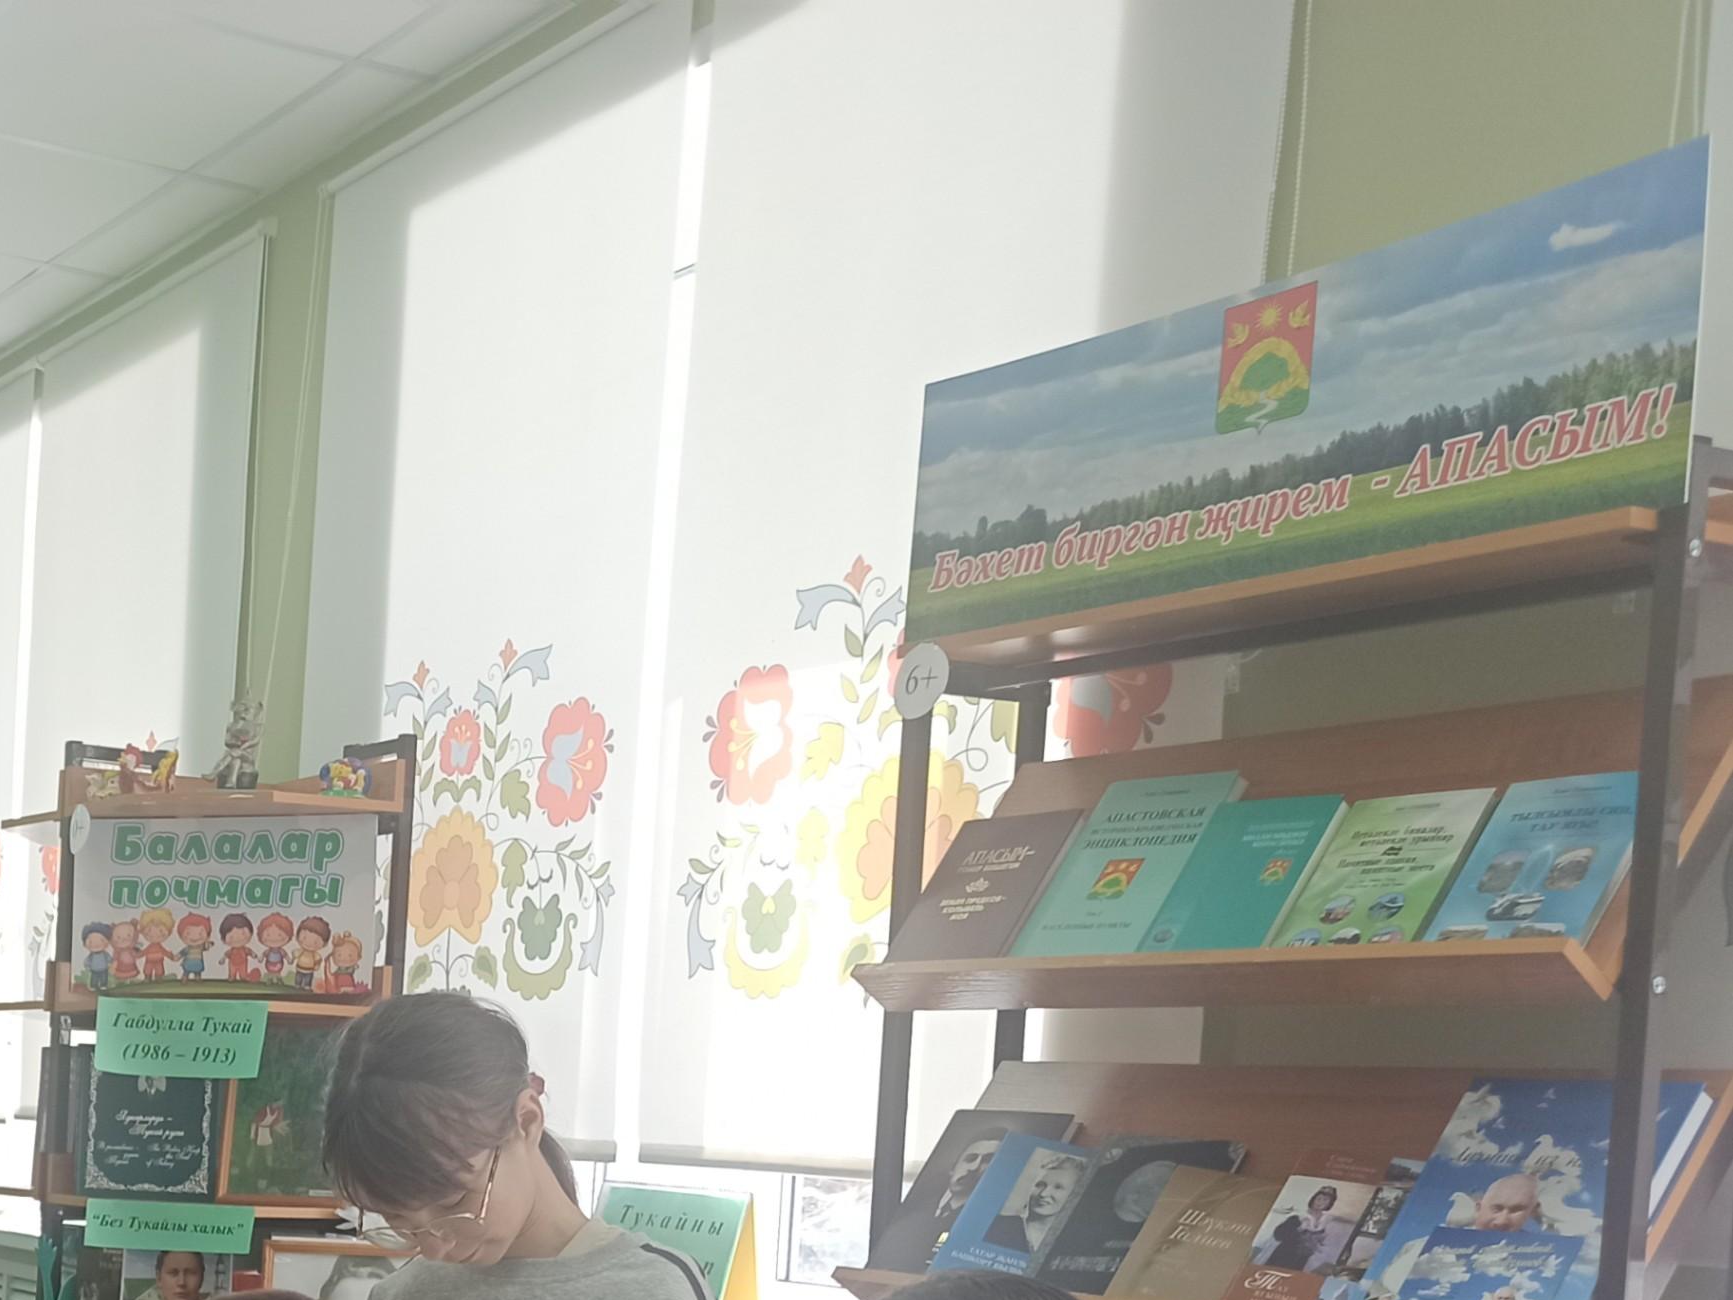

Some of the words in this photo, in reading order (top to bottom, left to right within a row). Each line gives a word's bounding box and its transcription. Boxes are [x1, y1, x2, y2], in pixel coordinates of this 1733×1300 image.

[929, 540, 1047, 593] Бәхет
[1053, 512, 1192, 570] биргән
[1197, 476, 1349, 543] җирем
[1396, 384, 1677, 498] АПАСЫМ!
[904, 670, 939, 694] 6+
[1104, 806, 1207, 823] АПАСТОВСКАЯ
[111, 823, 343, 874] Балалар
[1083, 833, 1199, 849] ЭНЦИКЛОПЕДИЯ
[109, 875, 343, 909] почмагы
[112, 1012, 195, 1036] Габдулла
[200, 1014, 253, 1036] Тукай
[122, 1045, 170, 1065] (1986
[192, 1046, 237, 1066] 1913)
[92, 1214, 123, 1228] “Без
[128, 1216, 187, 1233] Тукайлы
[191, 1223, 244, 1236] халык”
[620, 1204, 724, 1236] Тукайны
